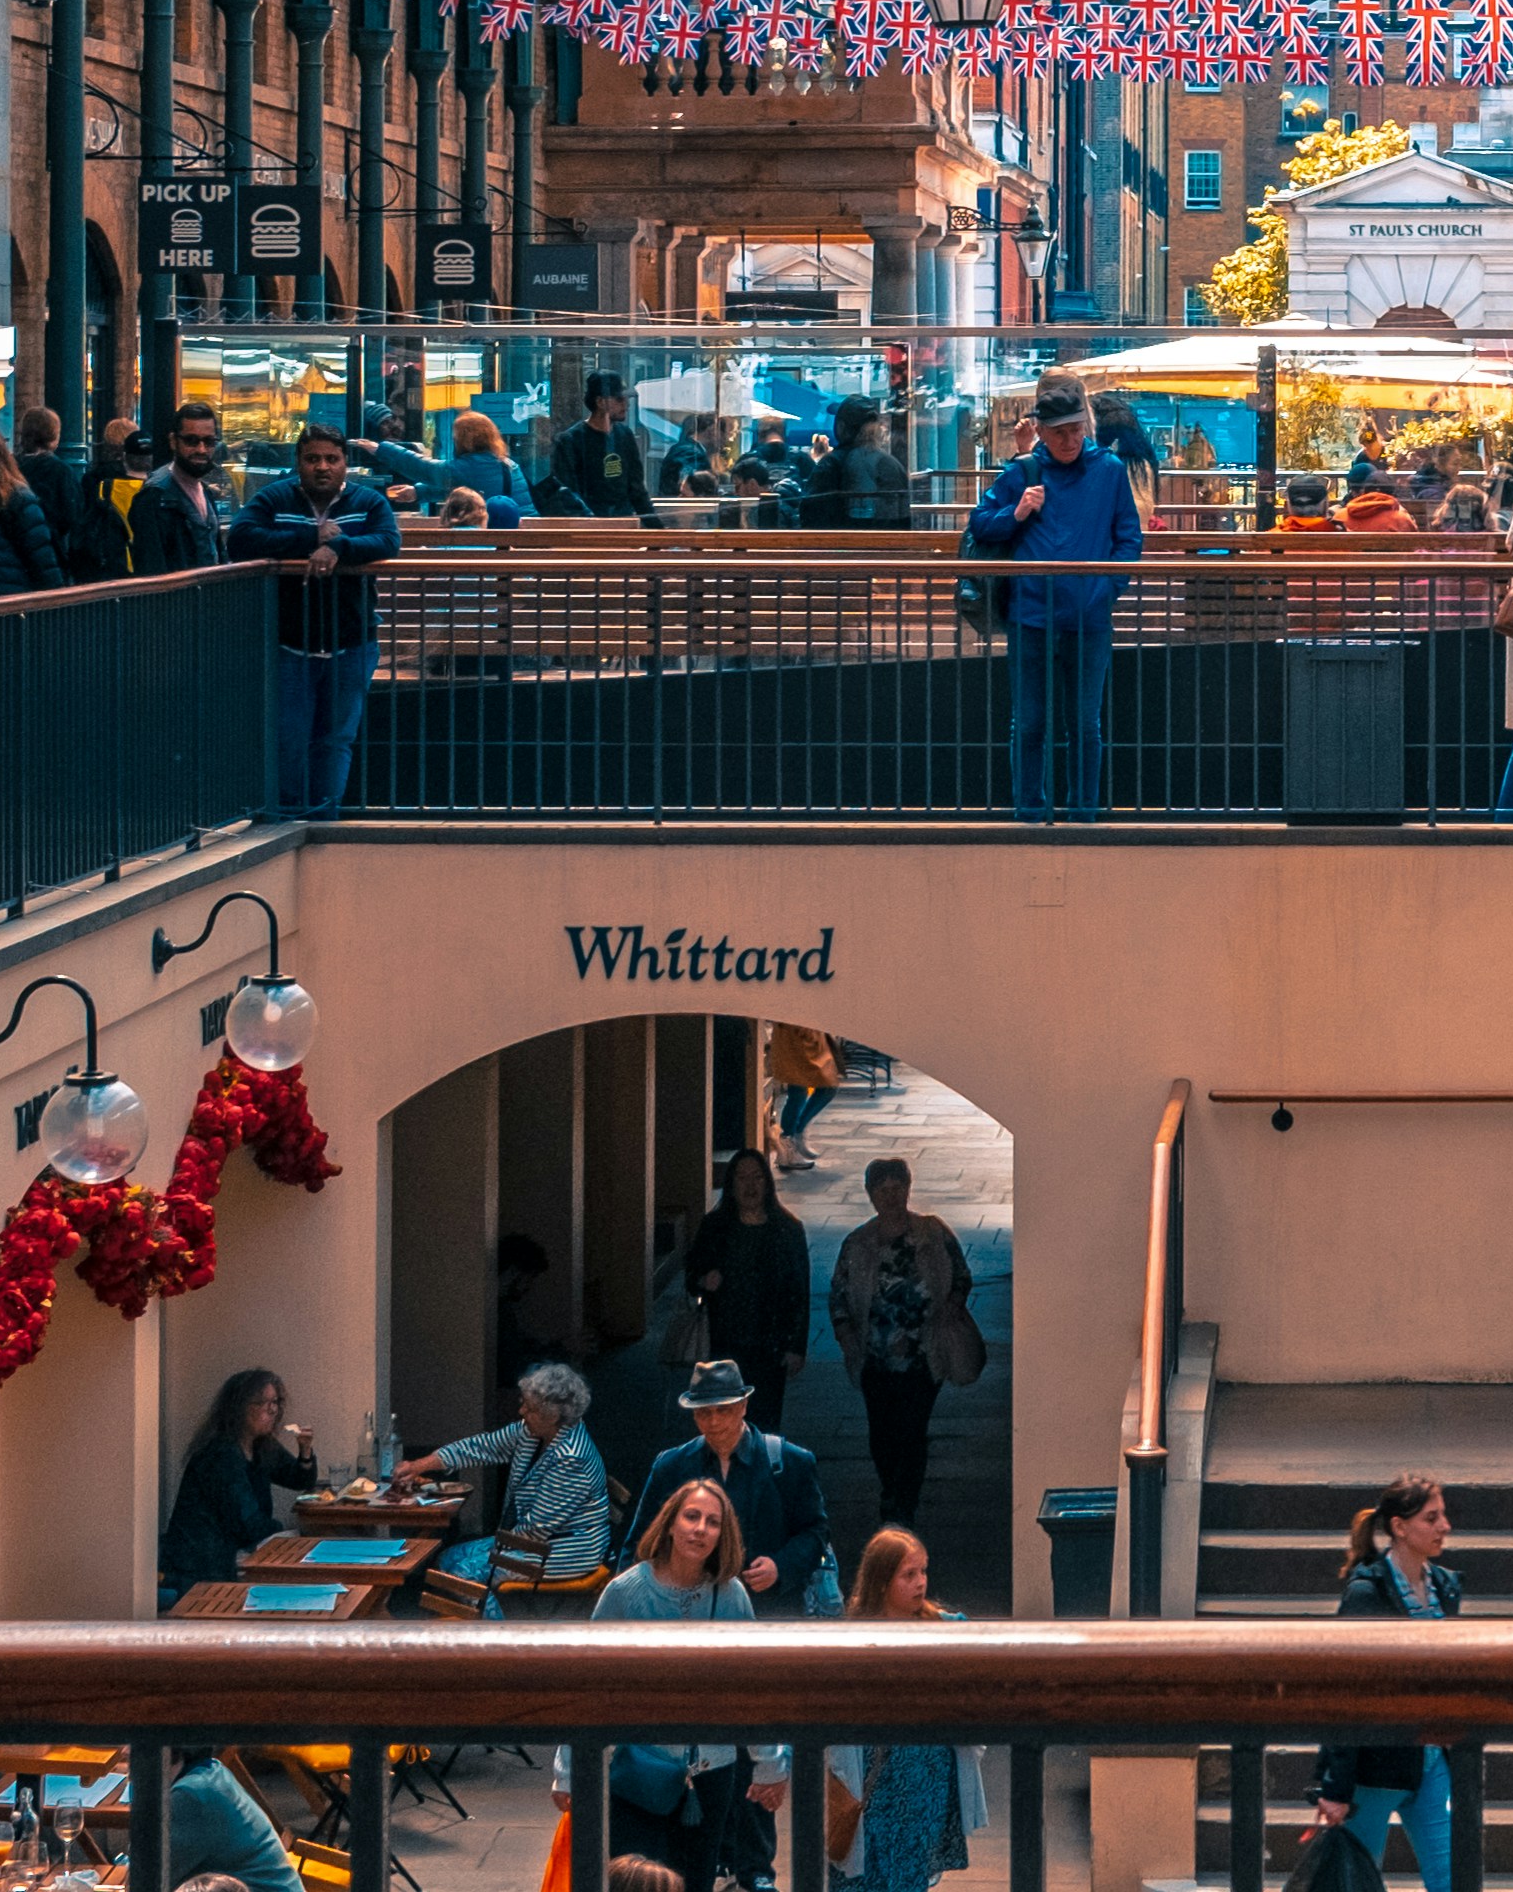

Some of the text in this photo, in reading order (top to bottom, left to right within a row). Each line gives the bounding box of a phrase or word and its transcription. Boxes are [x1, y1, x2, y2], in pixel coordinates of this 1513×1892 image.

[142, 184, 232, 203] PICK UP
[1349, 224, 1483, 237] ST PAUL'S CHURCH
[159, 249, 214, 267] HERE
[532, 273, 589, 285] AUBAINE
[564, 924, 836, 983] Whittard
